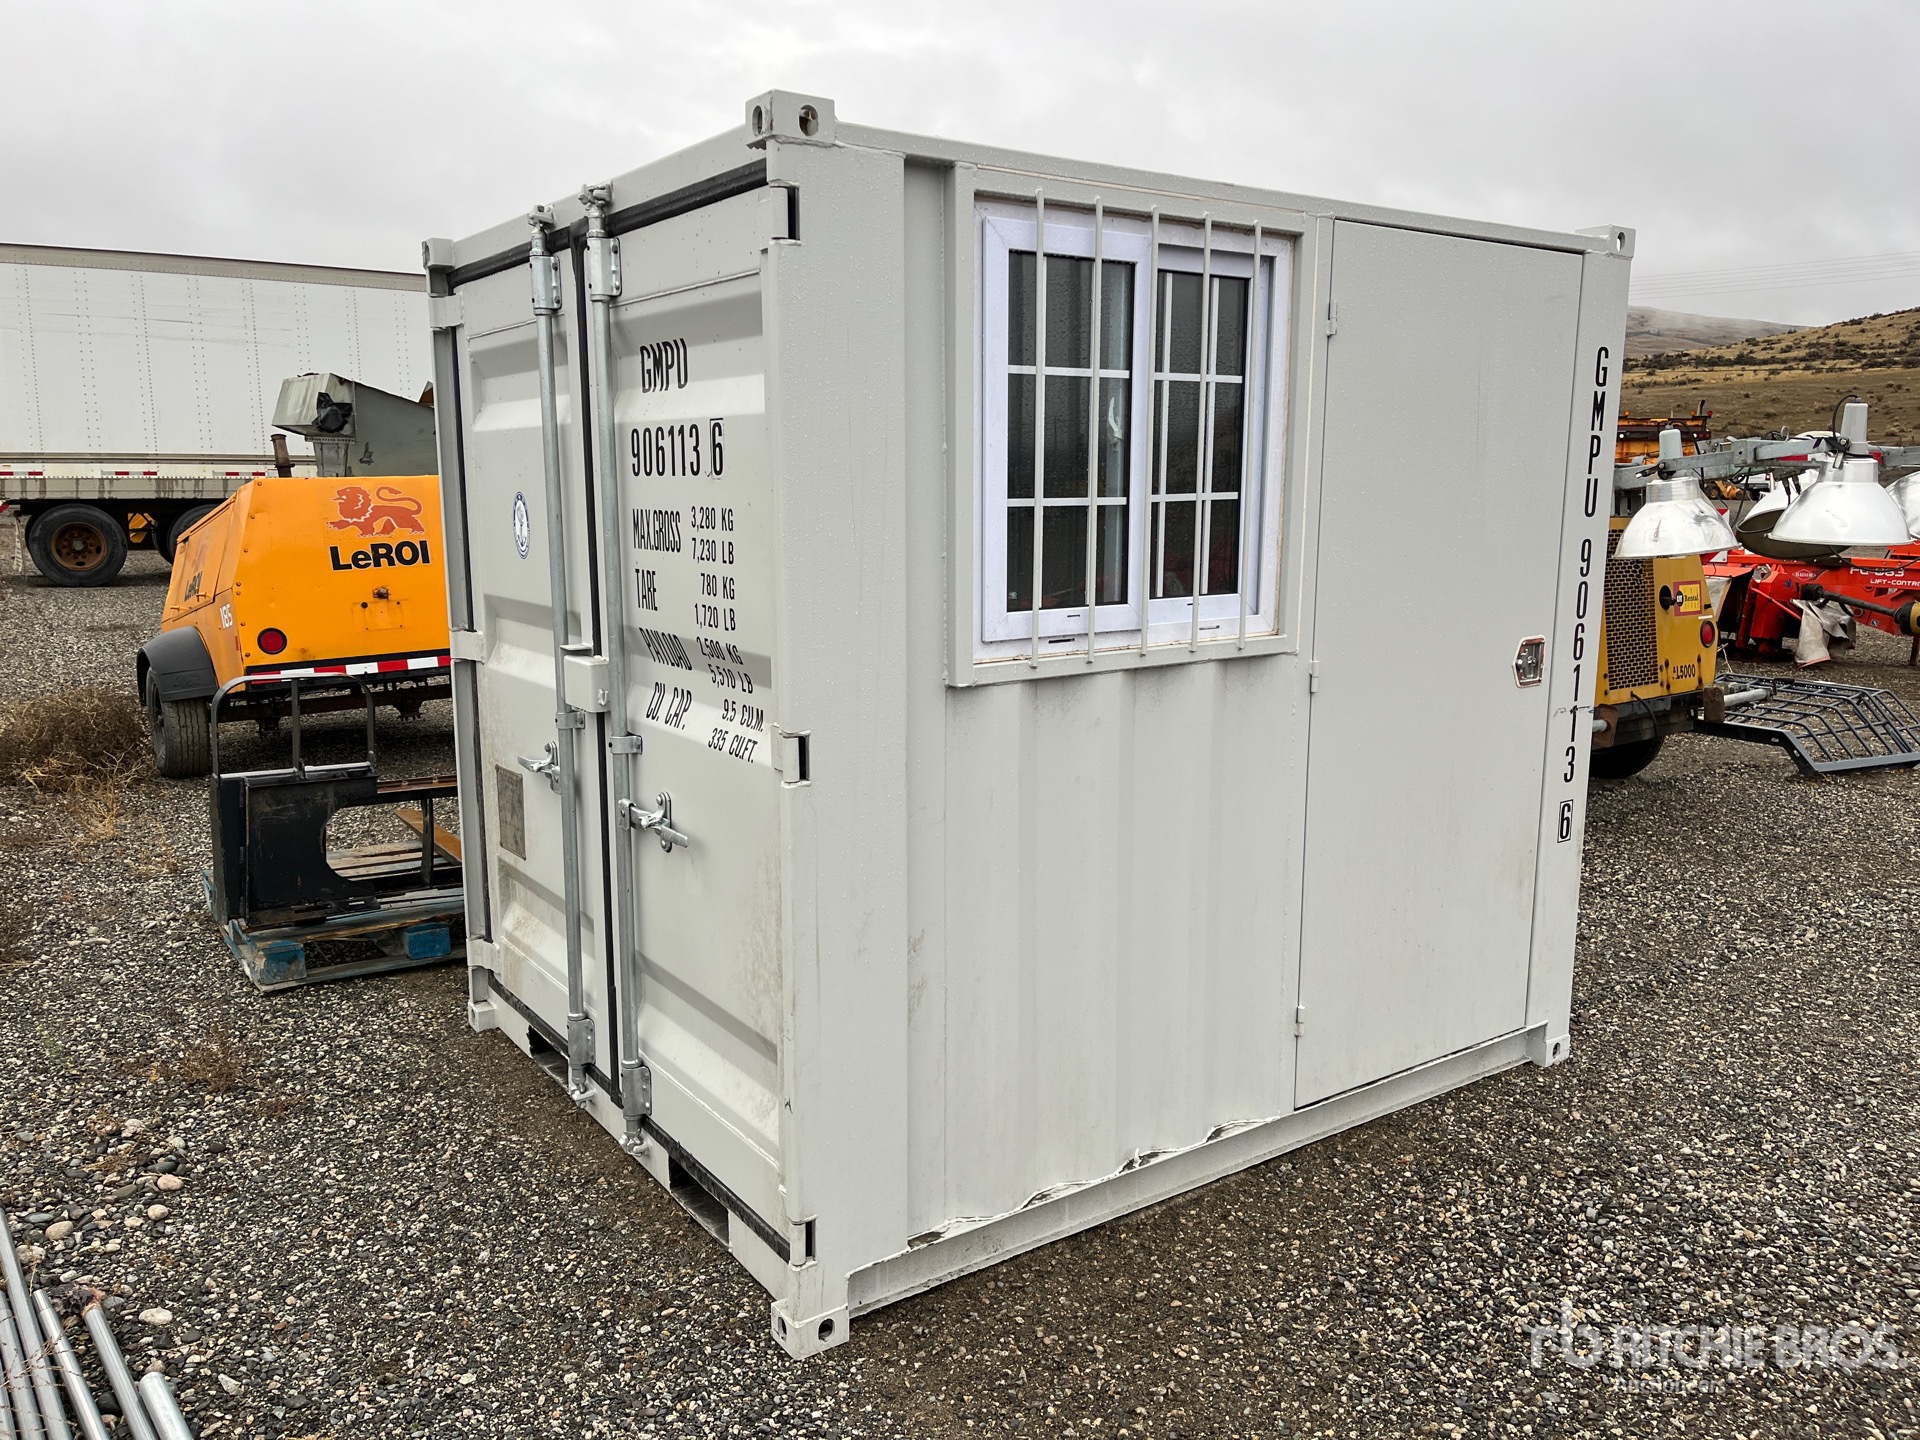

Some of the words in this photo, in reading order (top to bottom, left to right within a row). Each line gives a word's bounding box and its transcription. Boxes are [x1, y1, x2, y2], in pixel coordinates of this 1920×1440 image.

[639, 338, 688, 393] GMPU
[631, 423, 700, 476] 906113
[711, 421, 724, 476] 6
[1584, 346, 1609, 518] GMPU
[632, 508, 681, 553] MAX.GROSS
[691, 506, 716, 532] 3,280
[721, 508, 734, 531] KG
[329, 539, 430, 571] LeROI
[691, 538, 717, 564] 7,230
[721, 541, 735, 565] LB
[635, 568, 658, 611] TARE
[700, 573, 717, 597] 780
[723, 576, 735, 600] KG
[219, 603, 233, 629] 185
[694, 603, 719, 630] 1,720
[723, 608, 736, 631] LB
[639, 627, 692, 671] PAYLOAD
[696, 636, 726, 660] 2,500
[726, 642, 744, 665] KG
[1563, 538, 1592, 783] 906113
[708, 663, 736, 689] 5,510
[737, 671, 753, 694] LB
[646, 682, 666, 721] CU.
[722, 698, 737, 722] 9.5
[708, 727, 729, 751] 335
[1558, 801, 1572, 841] 6
